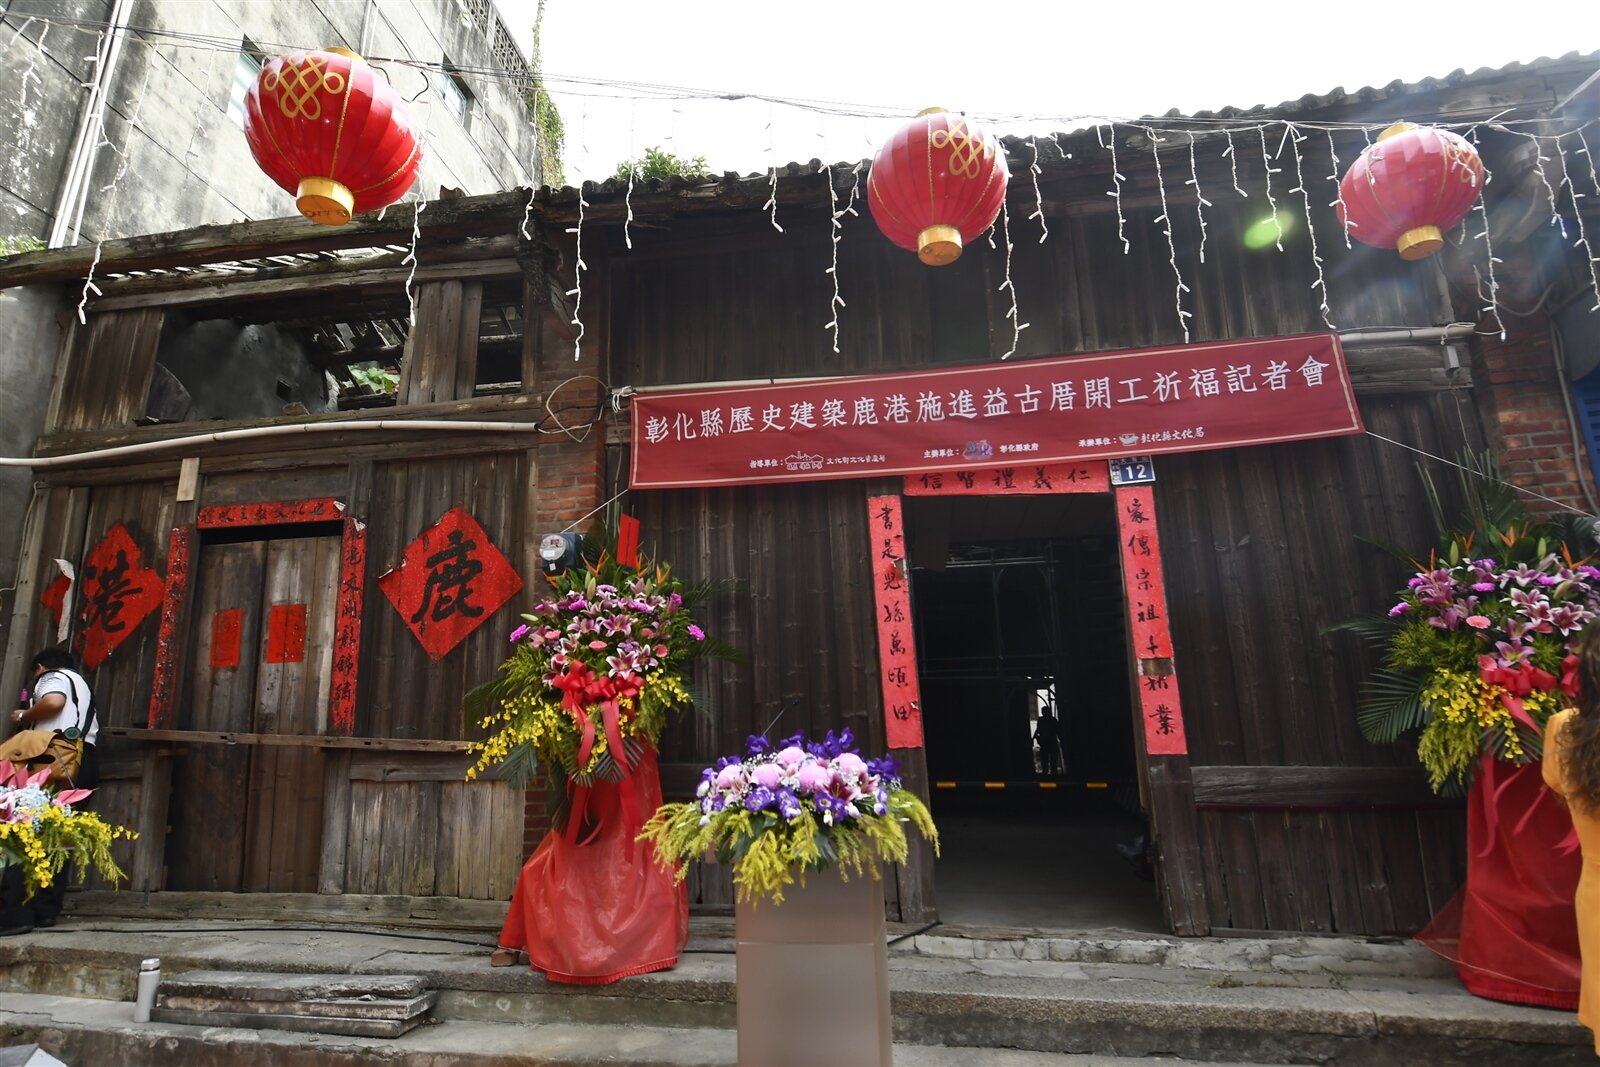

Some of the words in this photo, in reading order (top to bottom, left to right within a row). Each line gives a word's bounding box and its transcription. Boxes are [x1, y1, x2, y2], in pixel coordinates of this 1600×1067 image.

[644, 354, 1330, 444] 彰化縣歷史建築鹿港施進益古厝開工祈福記者會
[1125, 464, 1147, 480] 12
[411, 529, 485, 626] 鹿
